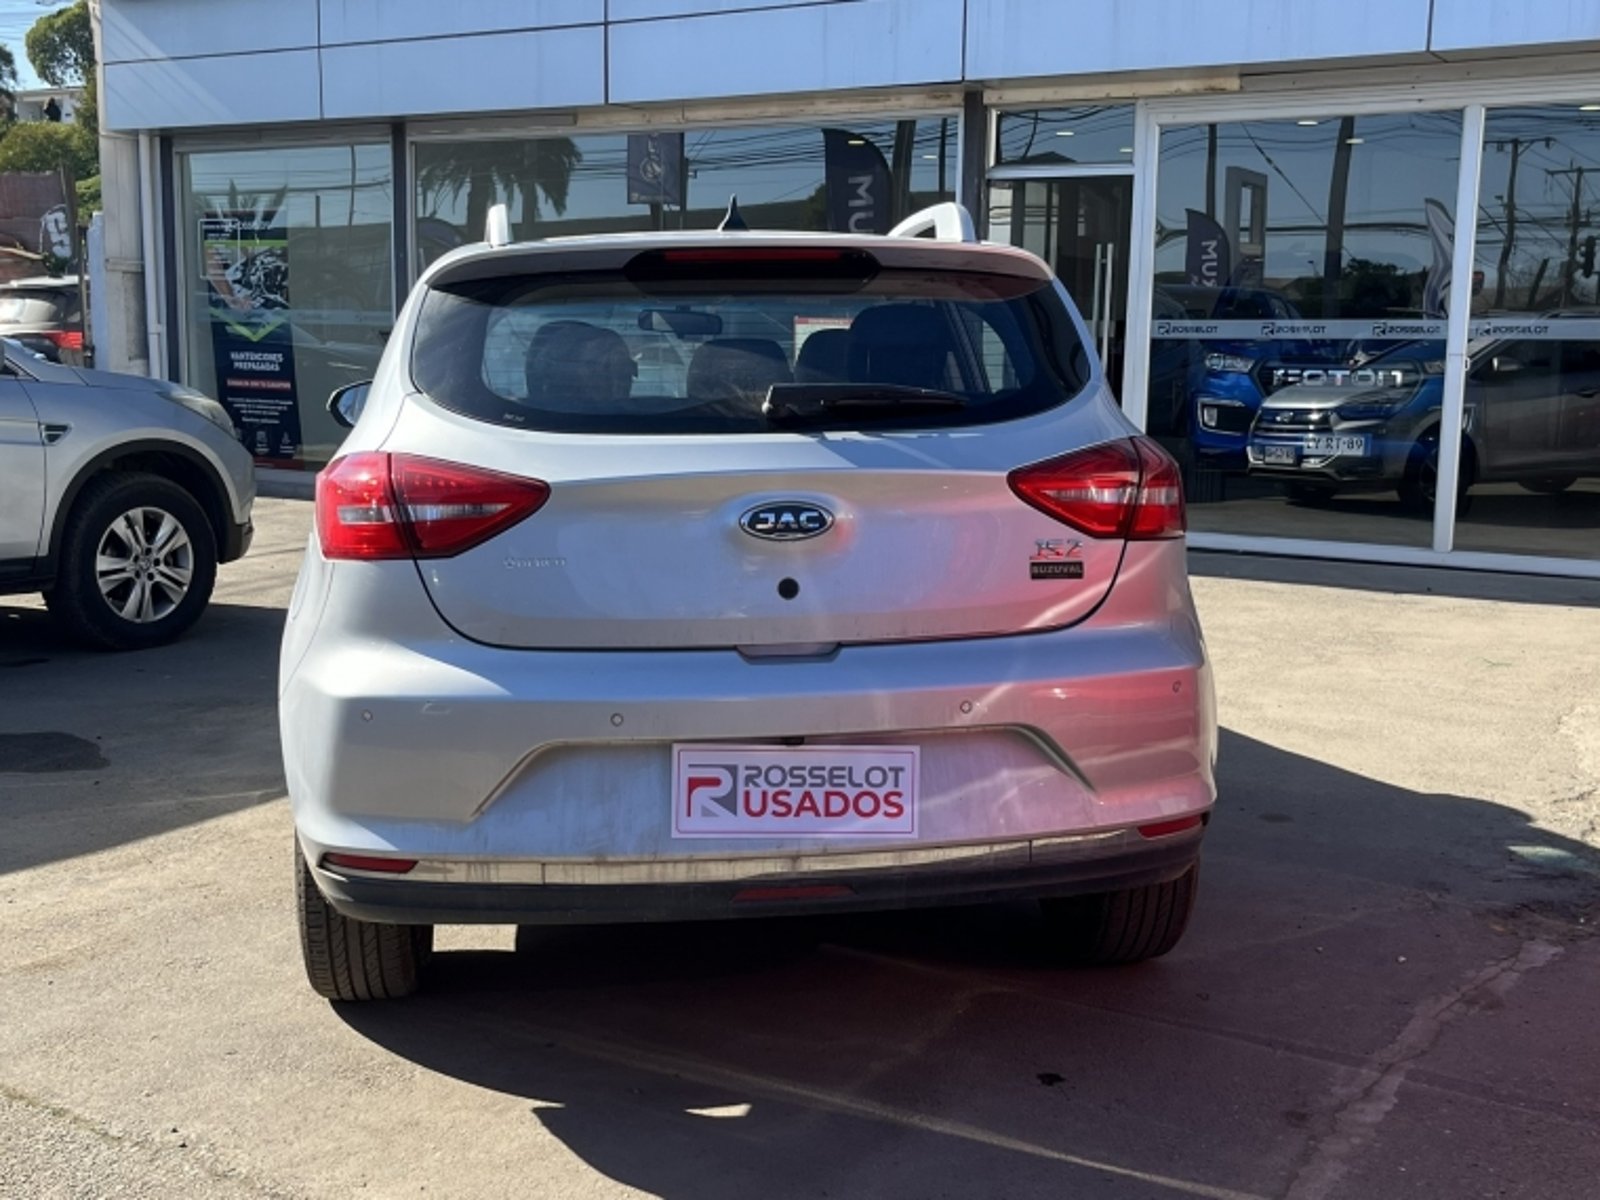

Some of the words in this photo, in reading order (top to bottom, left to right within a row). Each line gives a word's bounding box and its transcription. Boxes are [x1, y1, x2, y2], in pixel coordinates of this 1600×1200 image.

[1272, 369, 1403, 387] FOTON
[755, 511, 820, 530] JAC
[744, 765, 905, 788] ROSSELOT
[743, 790, 904, 818] USADOS
